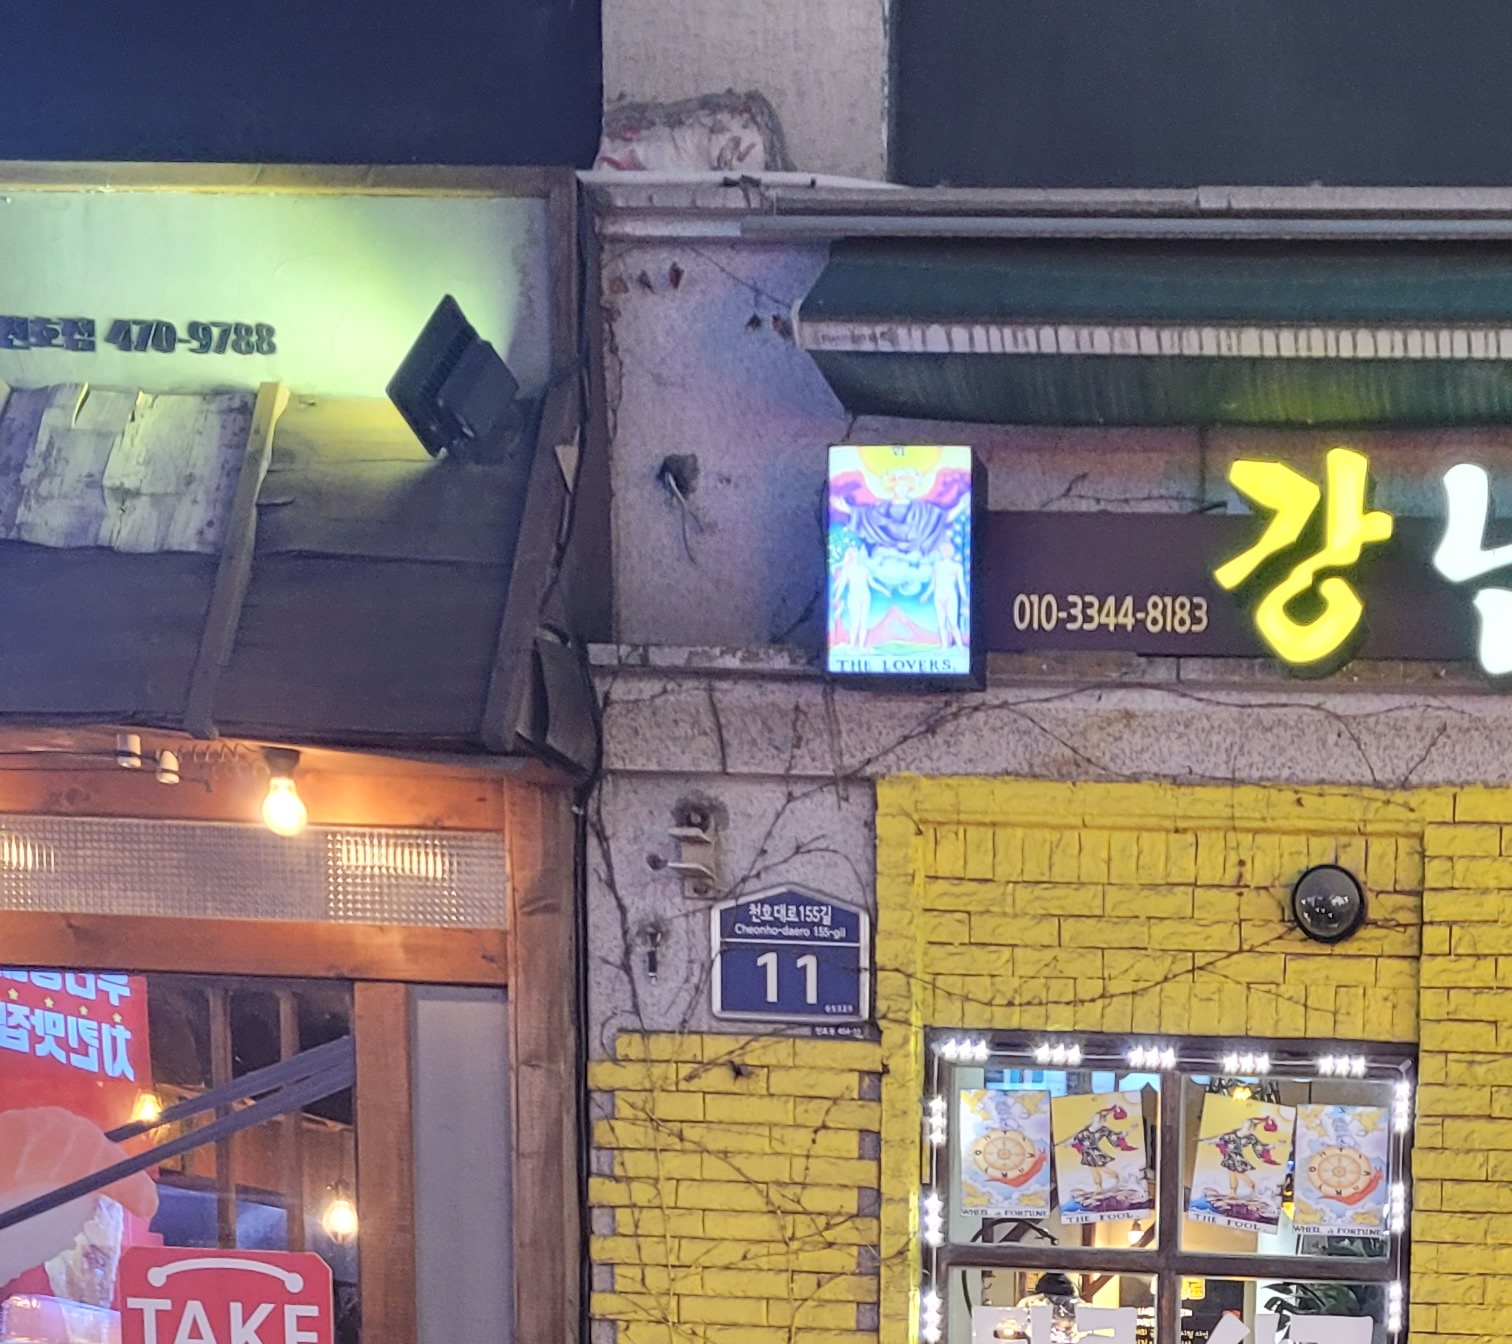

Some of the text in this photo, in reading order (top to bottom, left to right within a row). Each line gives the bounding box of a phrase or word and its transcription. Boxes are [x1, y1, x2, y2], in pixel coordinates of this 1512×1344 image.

[104, 318, 277, 355] 470-9788
[1013, 593, 1208, 634] 010-3344-8183
[749, 903, 832, 926] 천호대로155길
[756, 951, 818, 1005] 11
[1067, 1215, 1091, 1223] THE
[1194, 1213, 1217, 1224] THE
